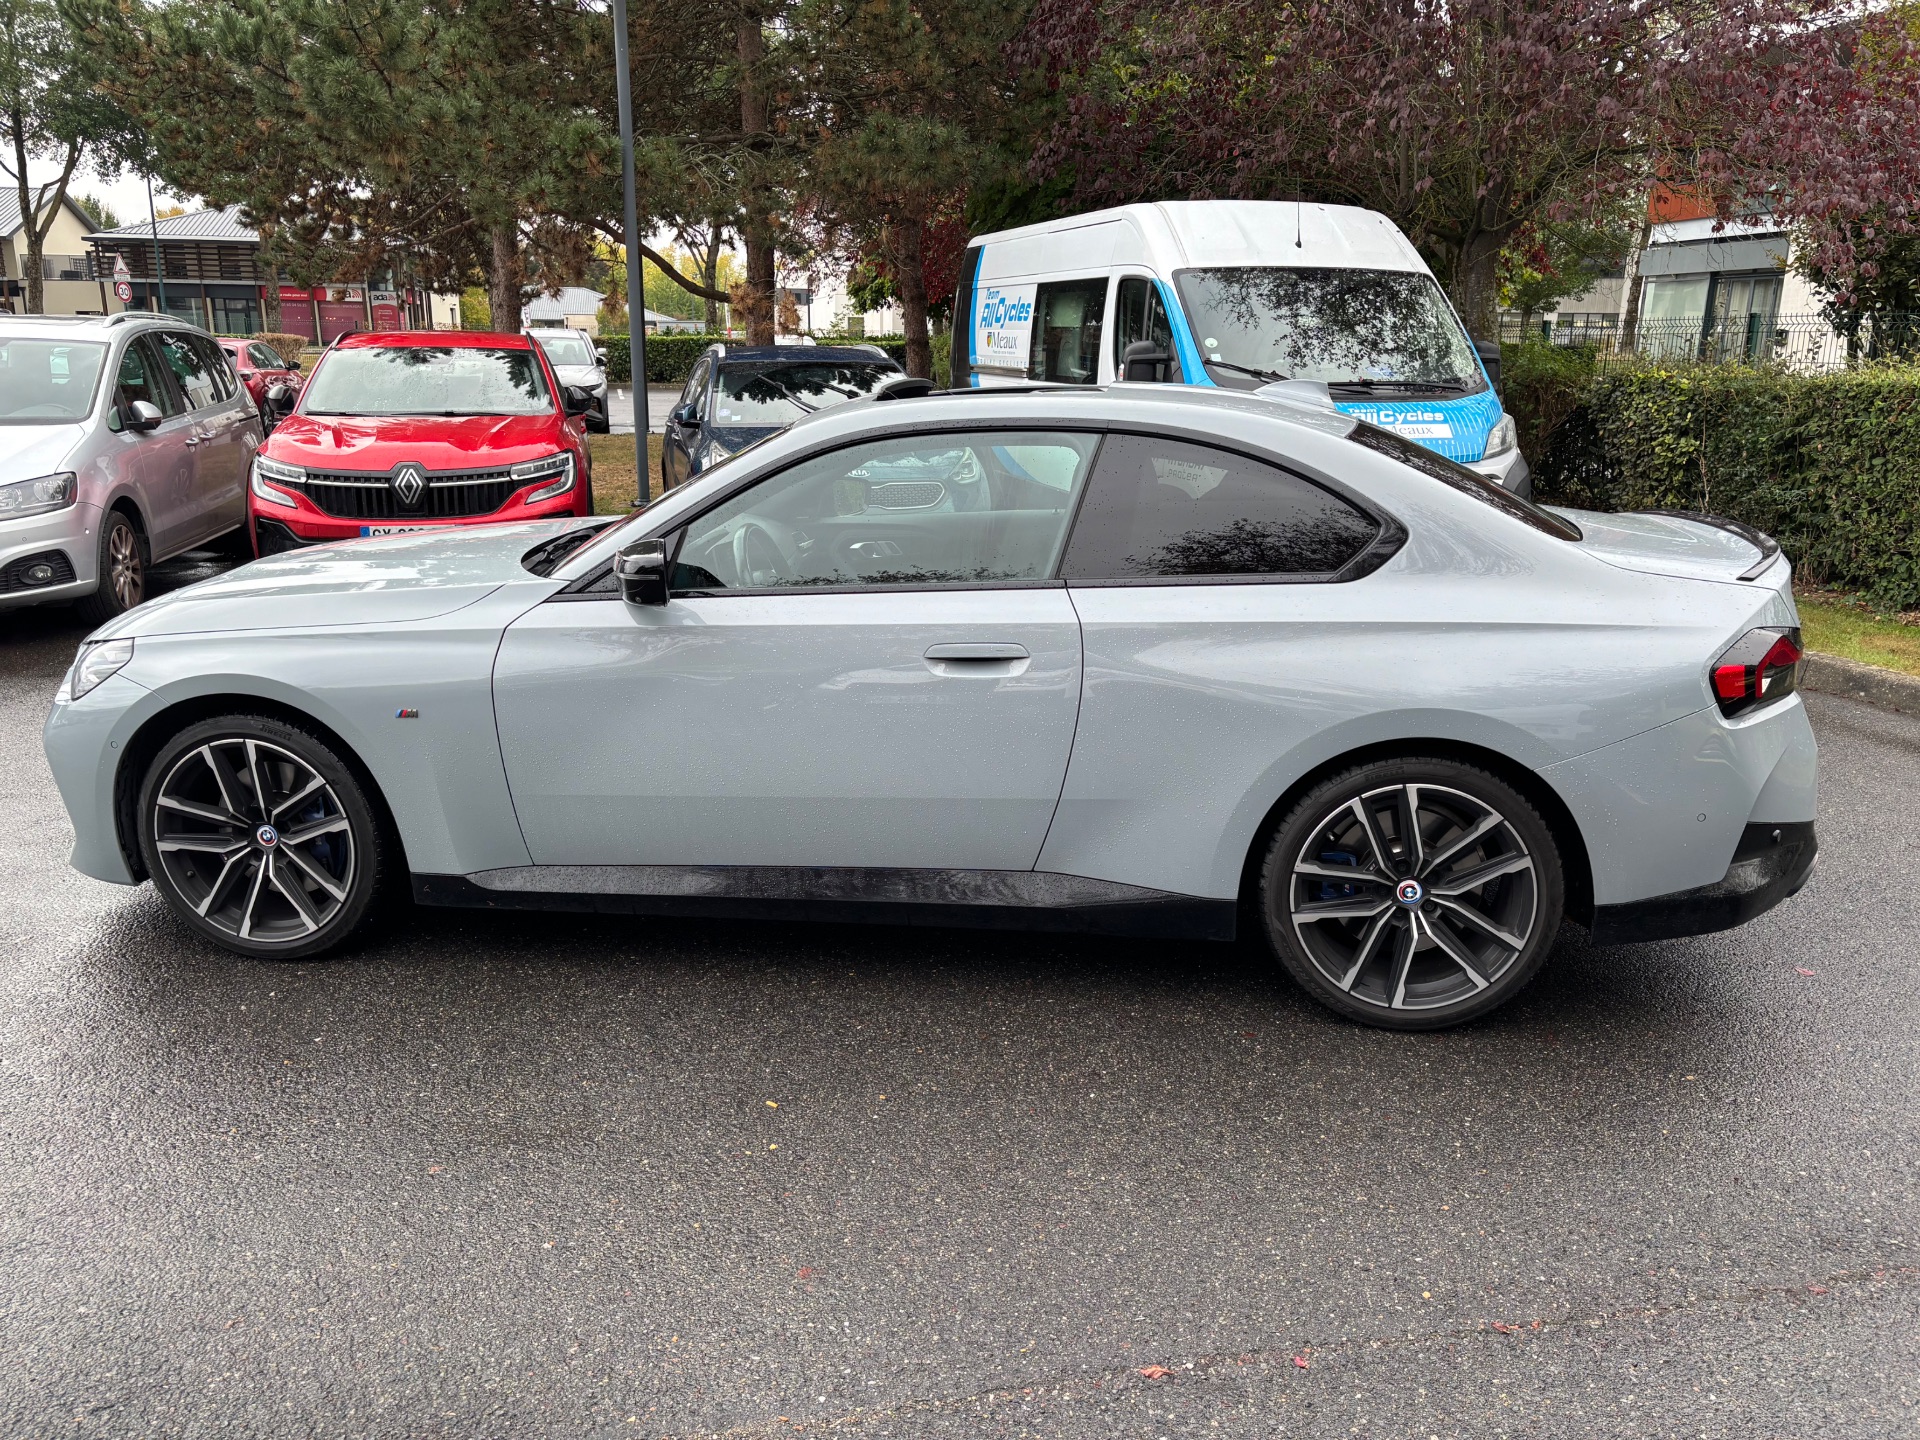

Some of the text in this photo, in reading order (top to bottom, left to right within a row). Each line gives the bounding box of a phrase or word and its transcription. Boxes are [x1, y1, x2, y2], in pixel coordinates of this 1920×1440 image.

[120, 287, 129, 296] 30
[373, 293, 388, 301] ada
[986, 288, 1000, 300] Team
[980, 296, 1032, 329] AllCycles
[991, 332, 1018, 349] Meaux
